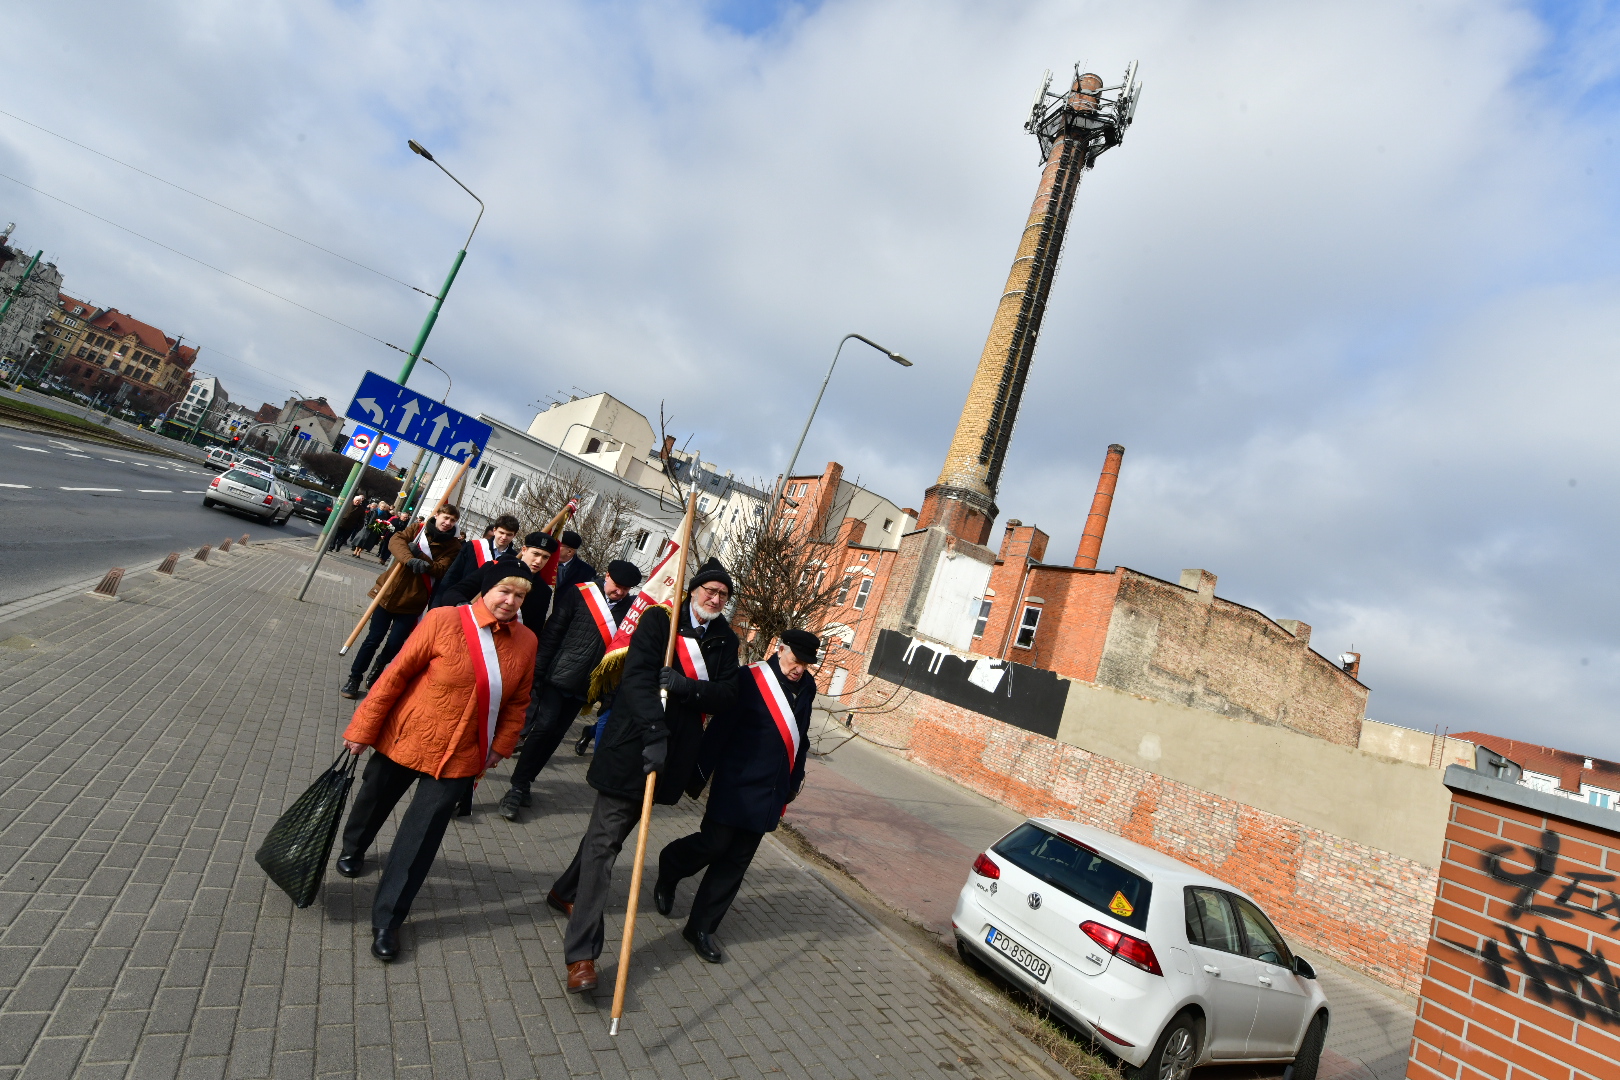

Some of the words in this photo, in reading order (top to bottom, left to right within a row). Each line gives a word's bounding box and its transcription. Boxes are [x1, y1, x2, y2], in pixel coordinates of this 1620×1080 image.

[663, 575, 675, 587] 19
[992, 931, 1010, 951] PO
[1010, 944, 1046, 976] 8S008
